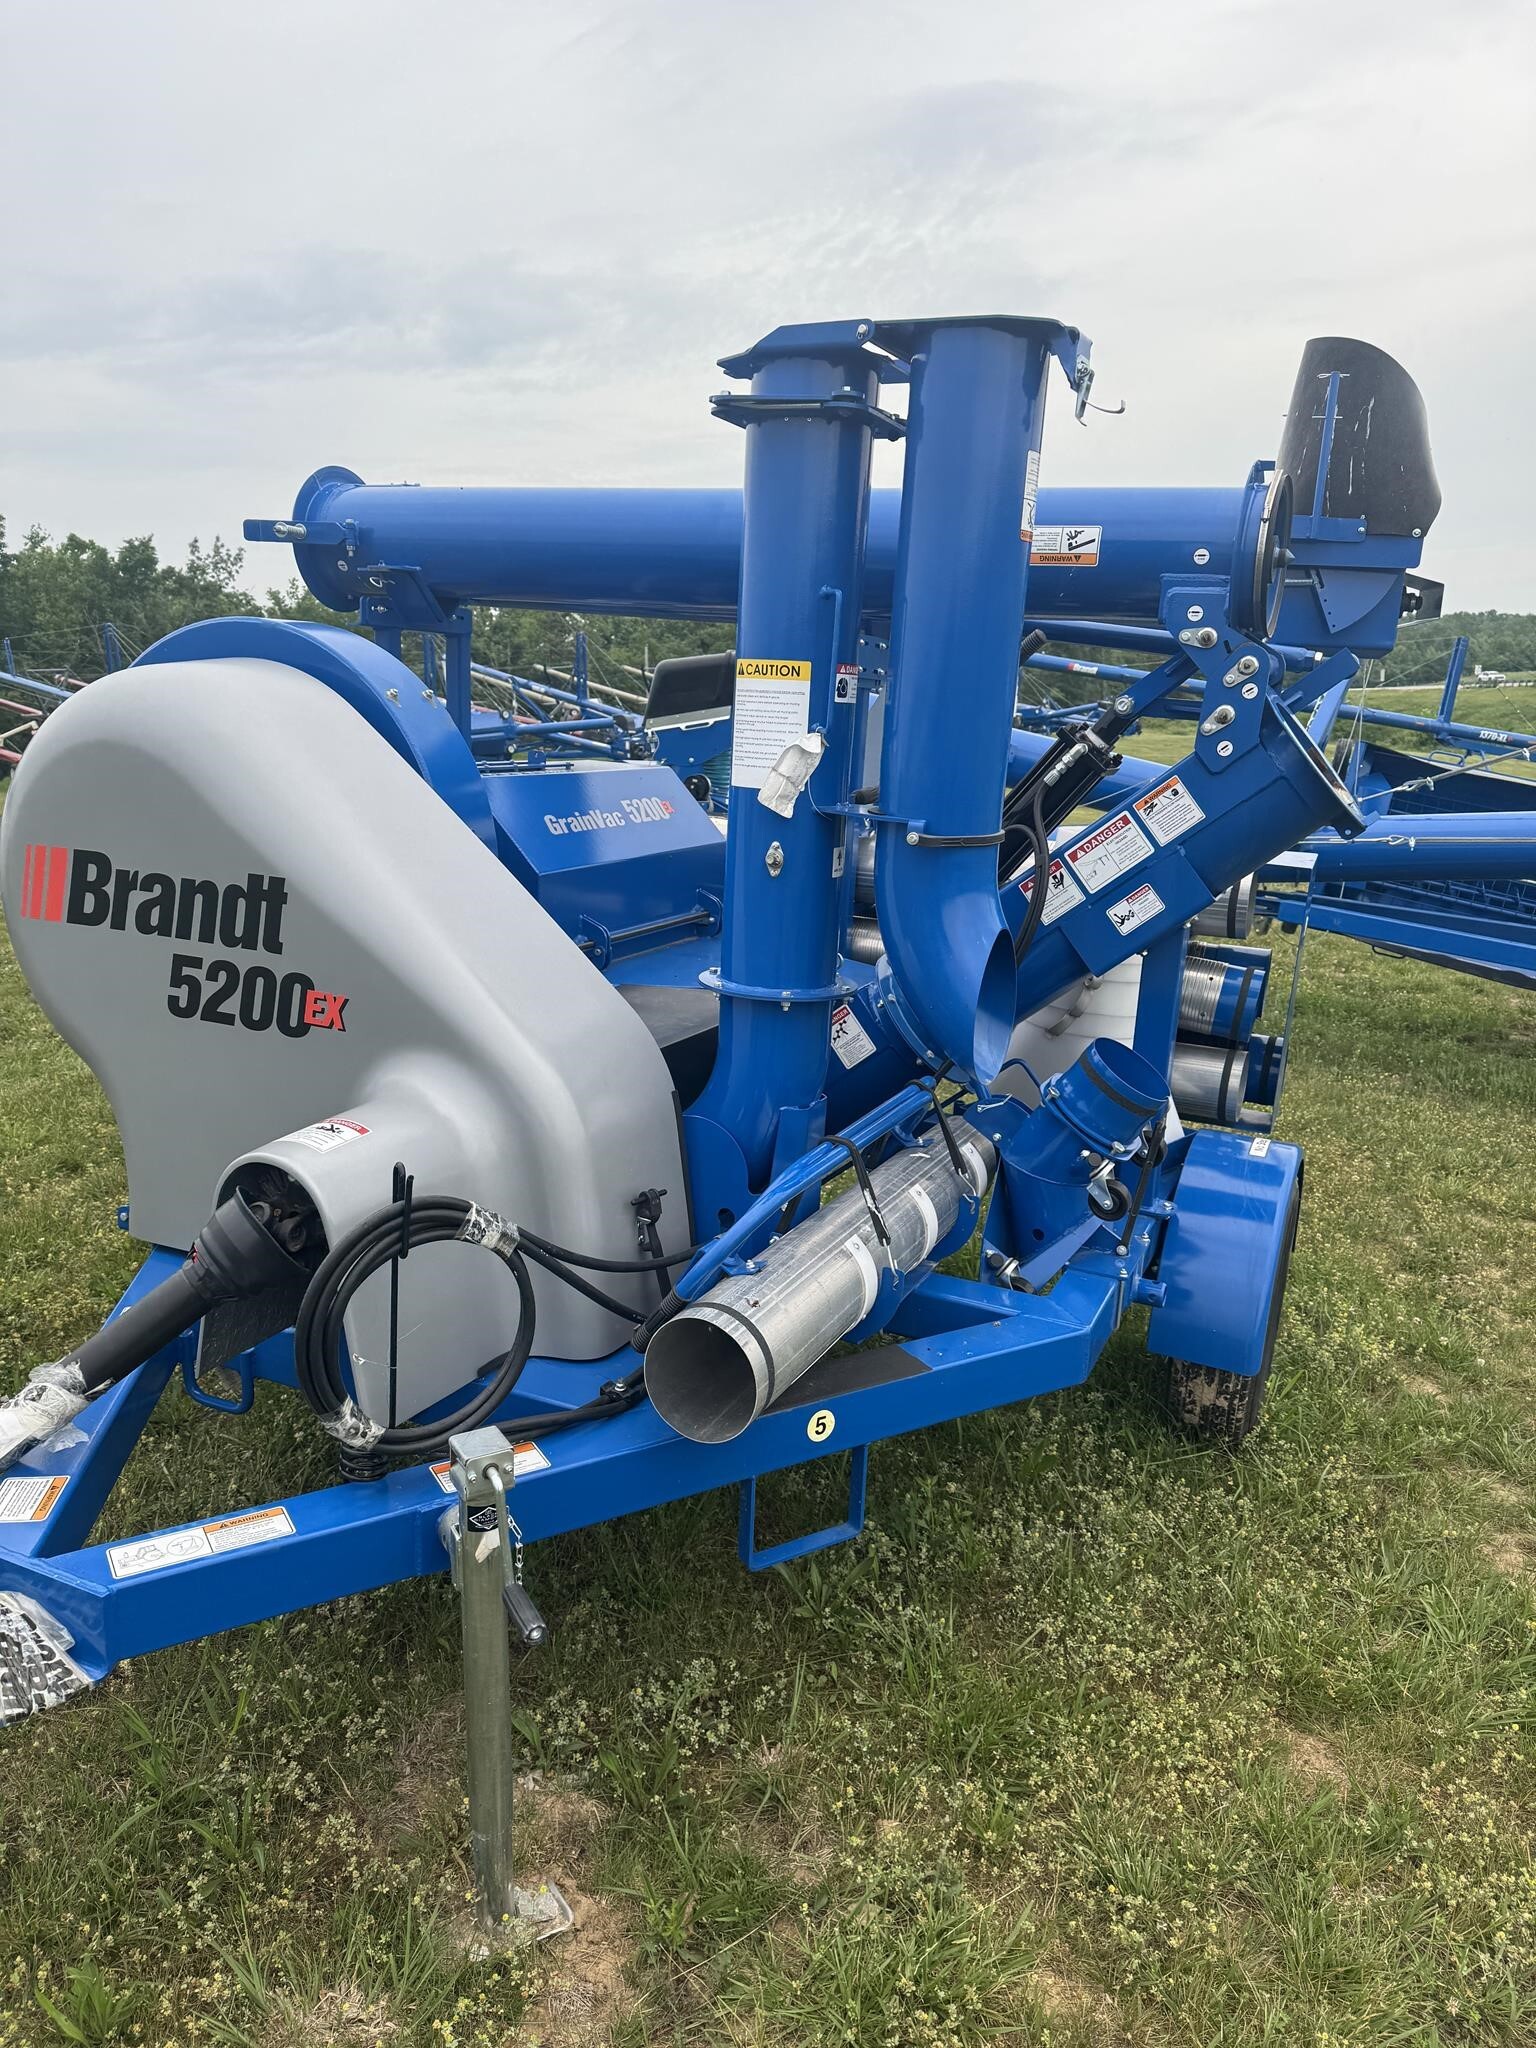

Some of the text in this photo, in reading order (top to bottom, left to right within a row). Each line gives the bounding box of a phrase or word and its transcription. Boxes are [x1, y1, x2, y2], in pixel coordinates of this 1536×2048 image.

[1039, 555, 1073, 563] WARNING
[745, 663, 801, 678] CAUTION
[543, 808, 626, 836] GrainVac
[1083, 819, 1126, 853] DANGER
[67, 849, 289, 955] Brandt
[814, 1415, 827, 1435] 5
[229, 1512, 269, 1525] WARNING
